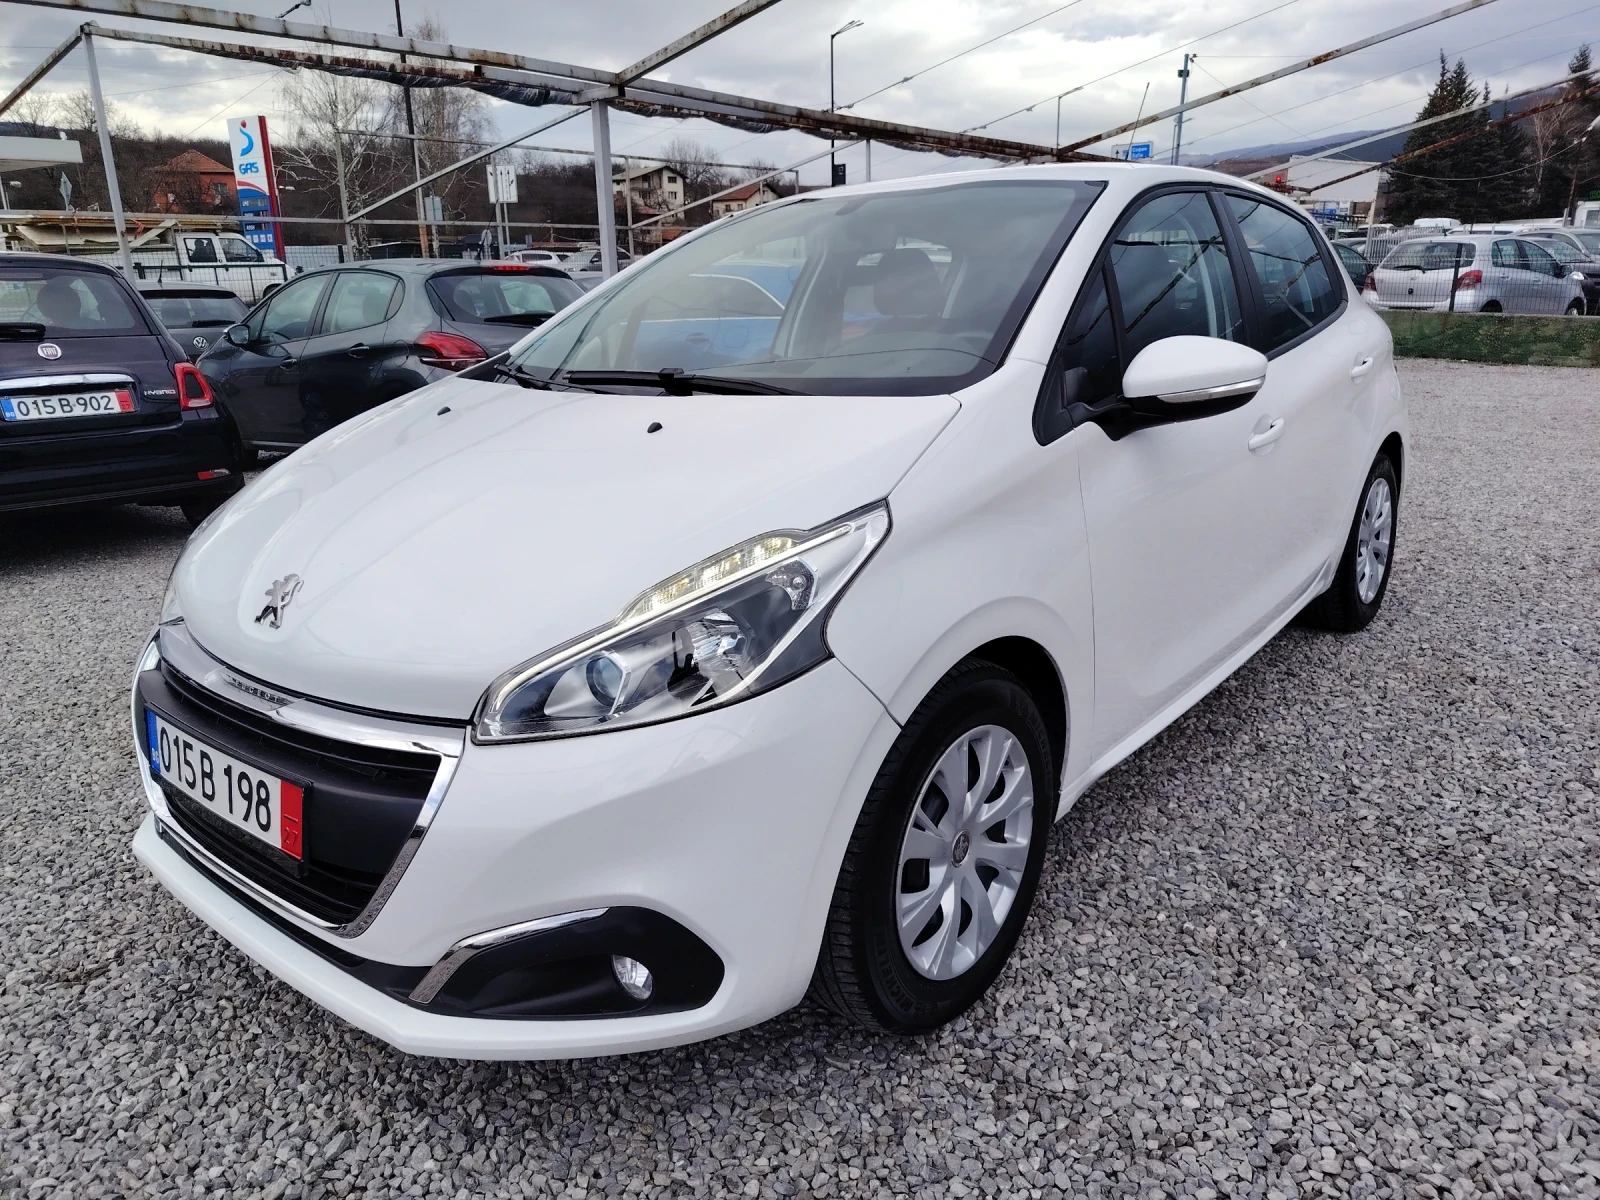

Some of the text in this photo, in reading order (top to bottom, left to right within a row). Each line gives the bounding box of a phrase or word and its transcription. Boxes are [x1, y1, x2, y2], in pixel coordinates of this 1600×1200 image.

[239, 162, 259, 175] GAS
[42, 347, 57, 355] FIAT
[151, 747, 160, 764] BG
[283, 826, 298, 847] 27
[875, 931, 914, 1012] MICHELIN
